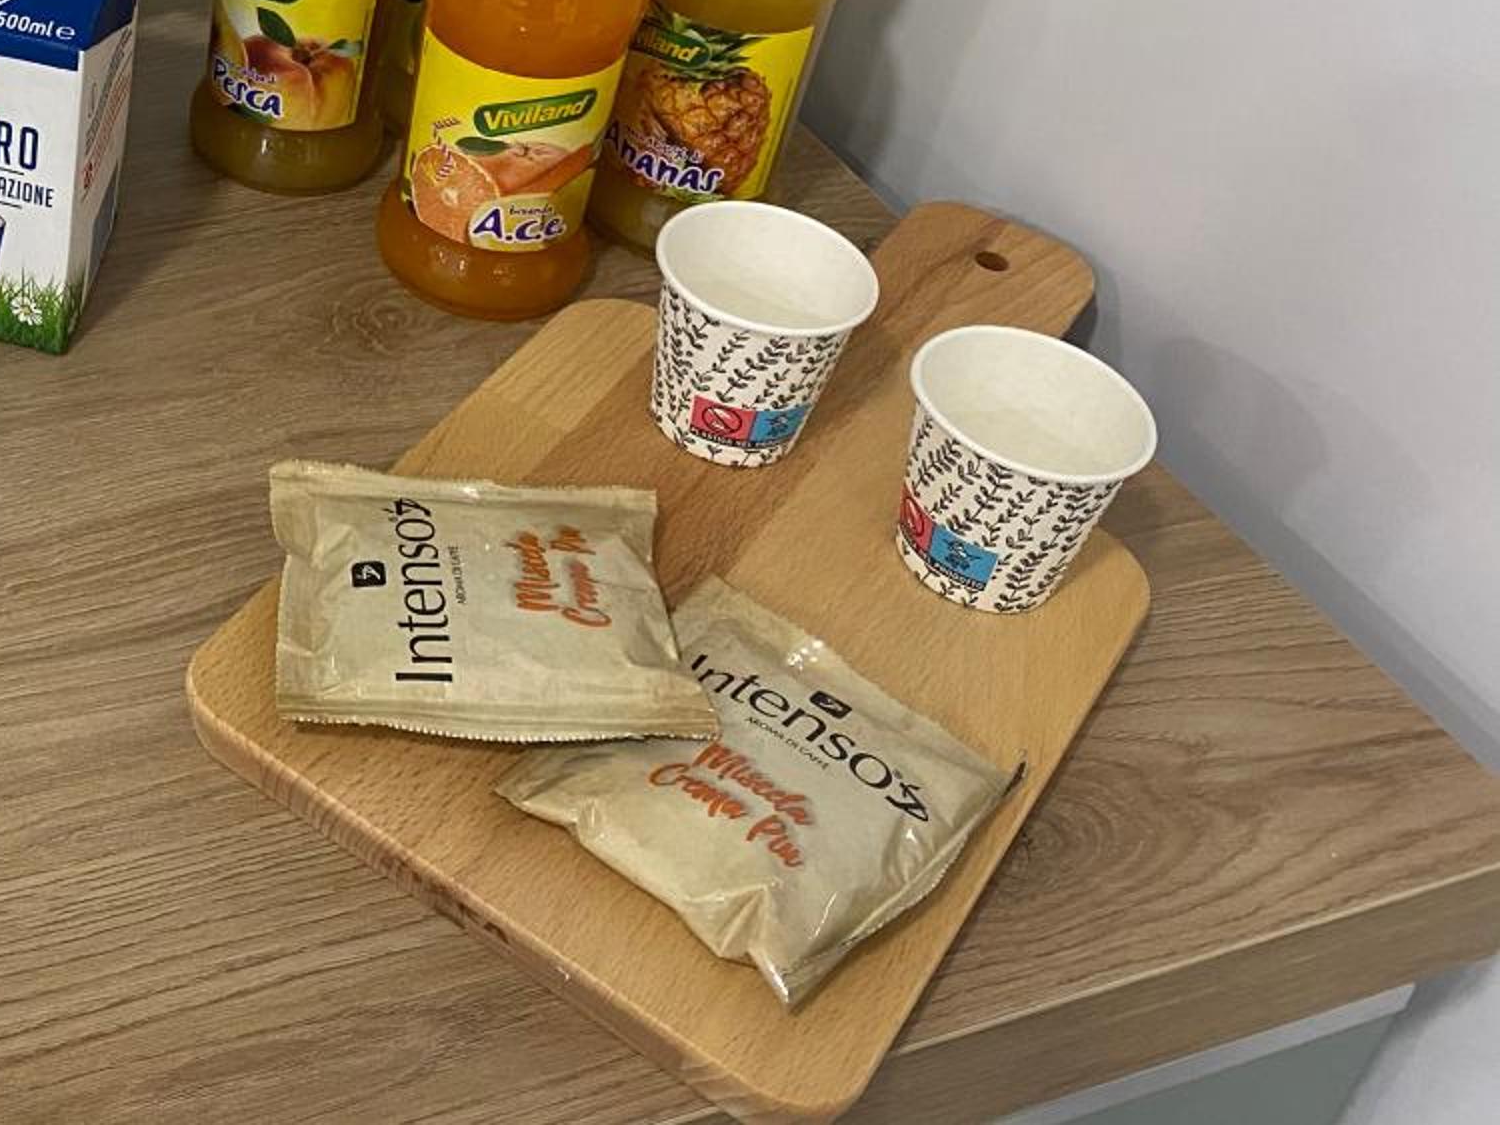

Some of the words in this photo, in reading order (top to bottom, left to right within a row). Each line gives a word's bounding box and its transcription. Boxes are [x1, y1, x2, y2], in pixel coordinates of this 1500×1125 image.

[214, 58, 282, 117] Pesca
[484, 94, 593, 131] Viviland
[605, 121, 723, 193] Ananas
[746, 715, 785, 741] AROMA
